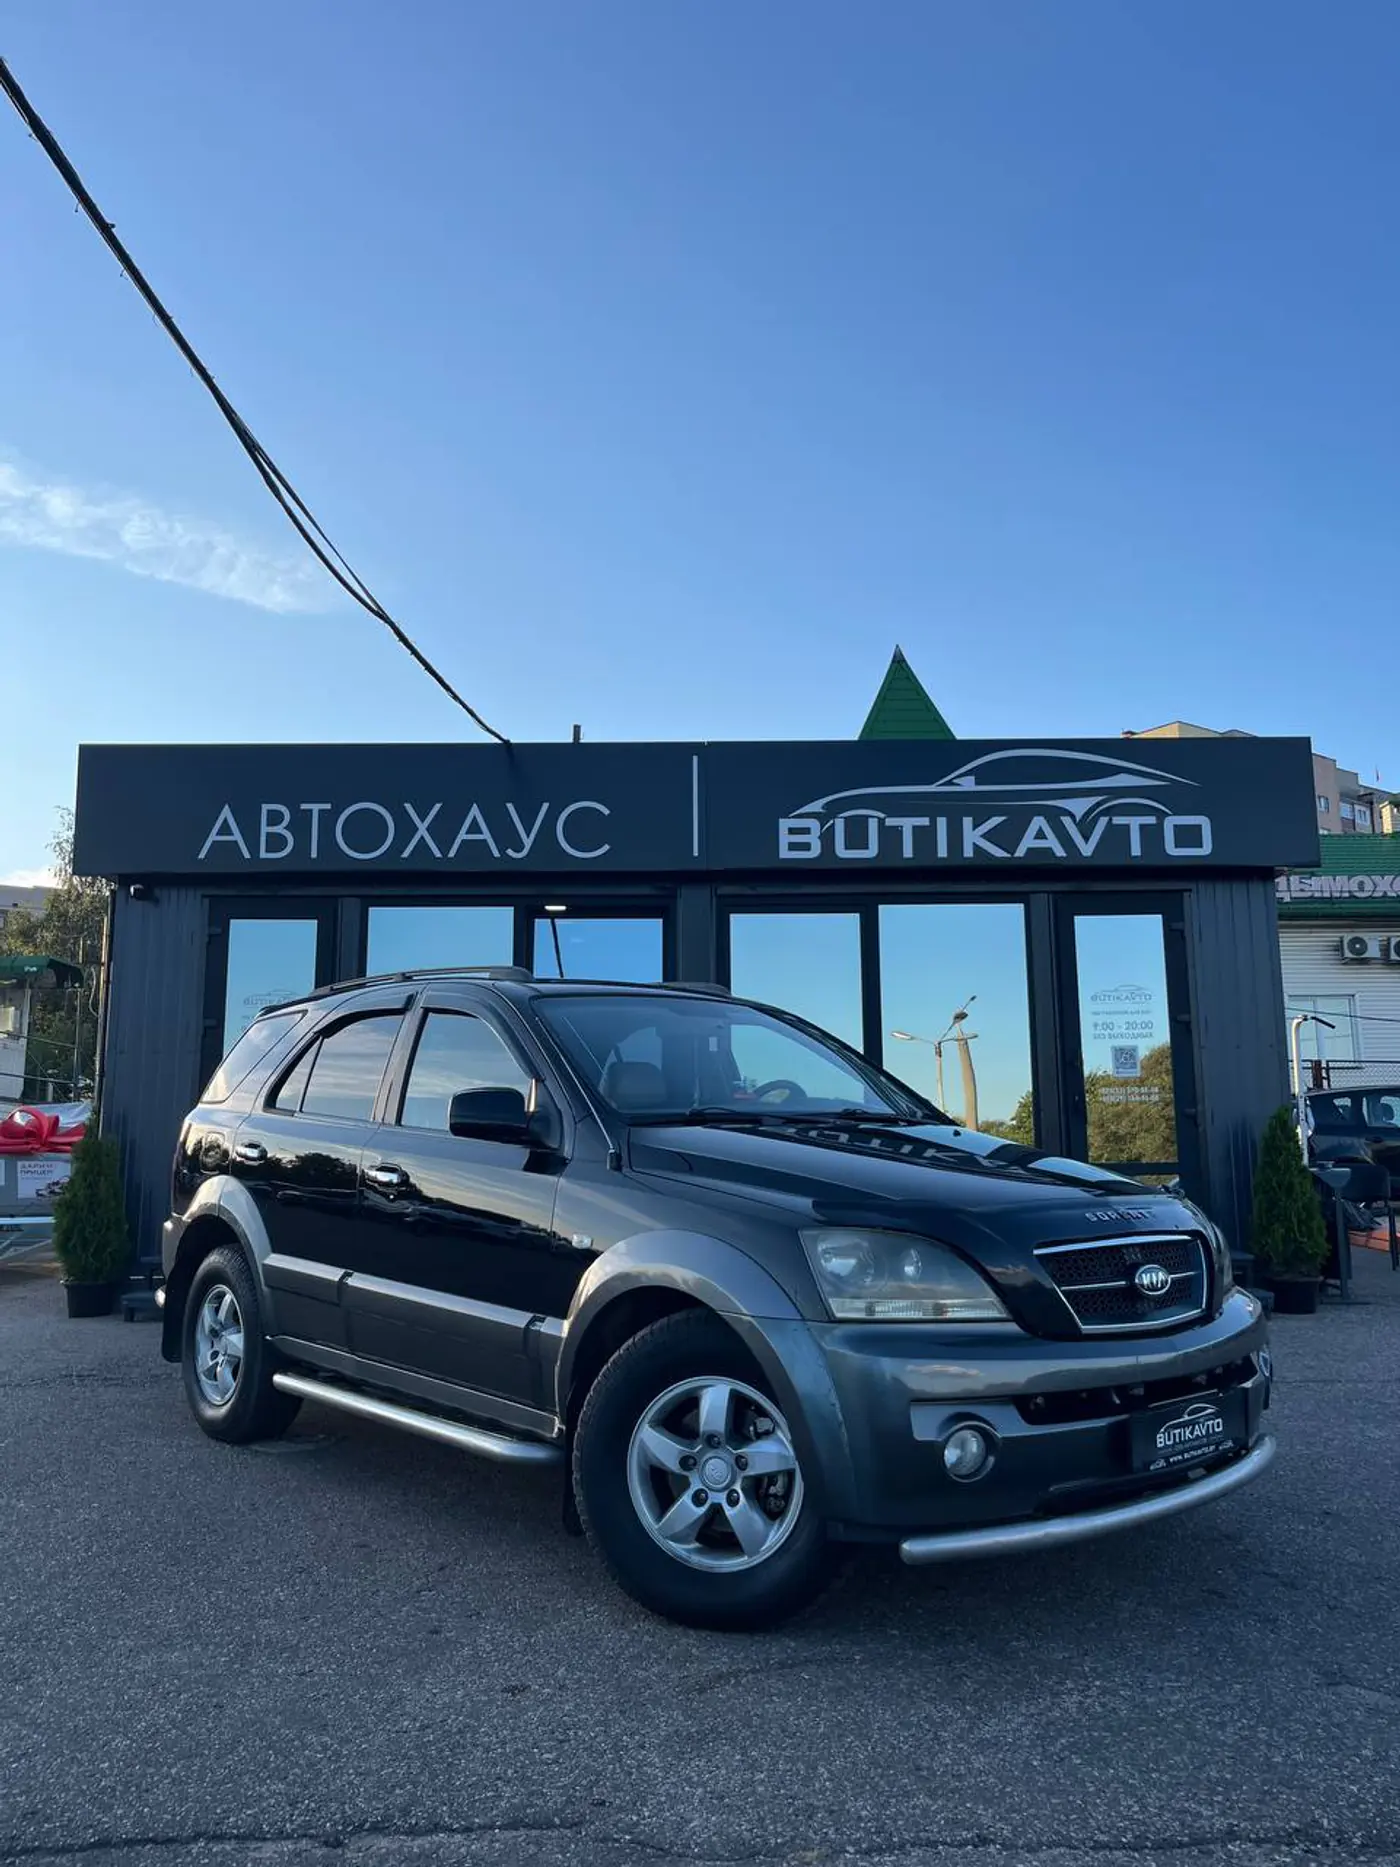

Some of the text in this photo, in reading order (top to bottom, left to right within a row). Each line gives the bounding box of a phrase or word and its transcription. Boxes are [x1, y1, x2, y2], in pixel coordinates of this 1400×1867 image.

[198, 800, 611, 860] АВТОХАУС
[778, 814, 1212, 859] BUTIKAVTO
[1124, 1020, 1154, 1031] 20:00
[1141, 1271, 1167, 1288] KIA
[1156, 1418, 1223, 1447] BUTIKAVTO
